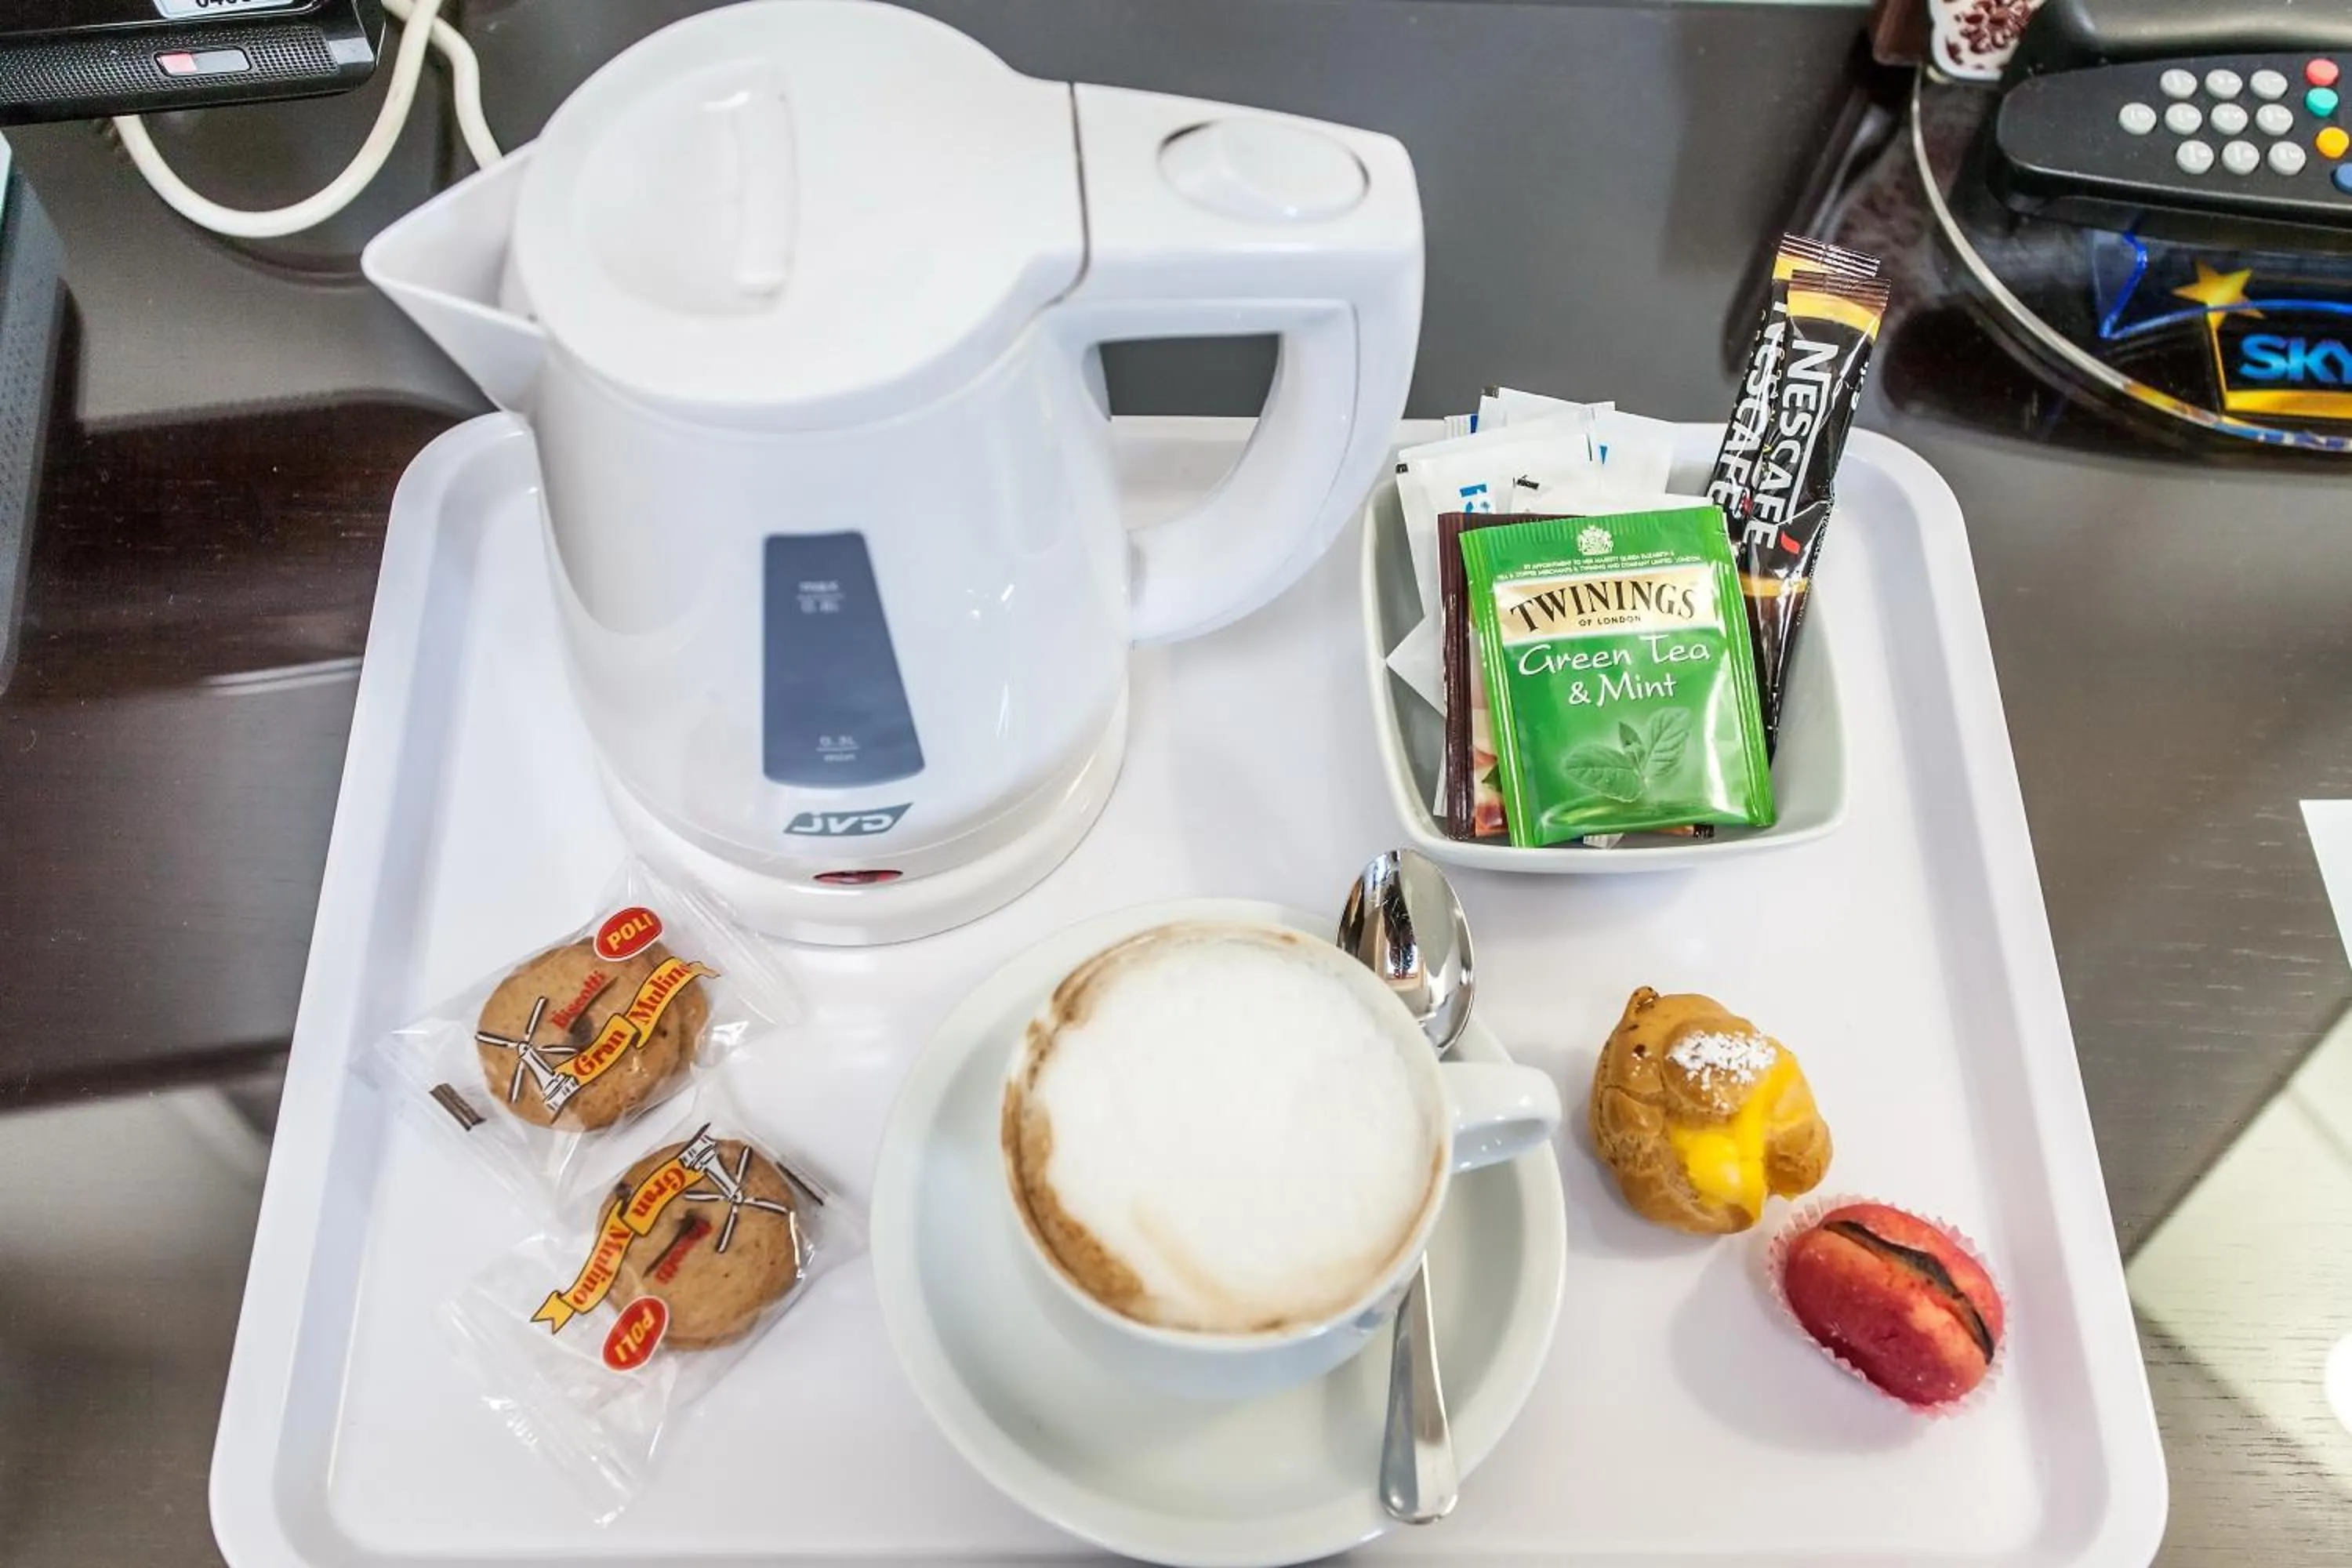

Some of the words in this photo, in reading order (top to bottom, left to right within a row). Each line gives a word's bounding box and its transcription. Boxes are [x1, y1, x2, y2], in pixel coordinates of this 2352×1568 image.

[1510, 580, 1696, 633] TWININGS
[1578, 618, 1593, 626] OF
[1597, 615, 1642, 626] LONDON
[1519, 644, 1632, 676] Green
[1639, 634, 1711, 664] Tea
[1569, 681, 1592, 705] &
[1596, 671, 1678, 708] Mint
[791, 811, 893, 834] JVD
[607, 913, 654, 952] POLI
[550, 971, 606, 1030] Biscotti
[573, 1029, 627, 1076] Gran
[632, 1167, 686, 1218] Gran
[572, 1225, 631, 1305] Mulino
[615, 1307, 655, 1363] POLI
